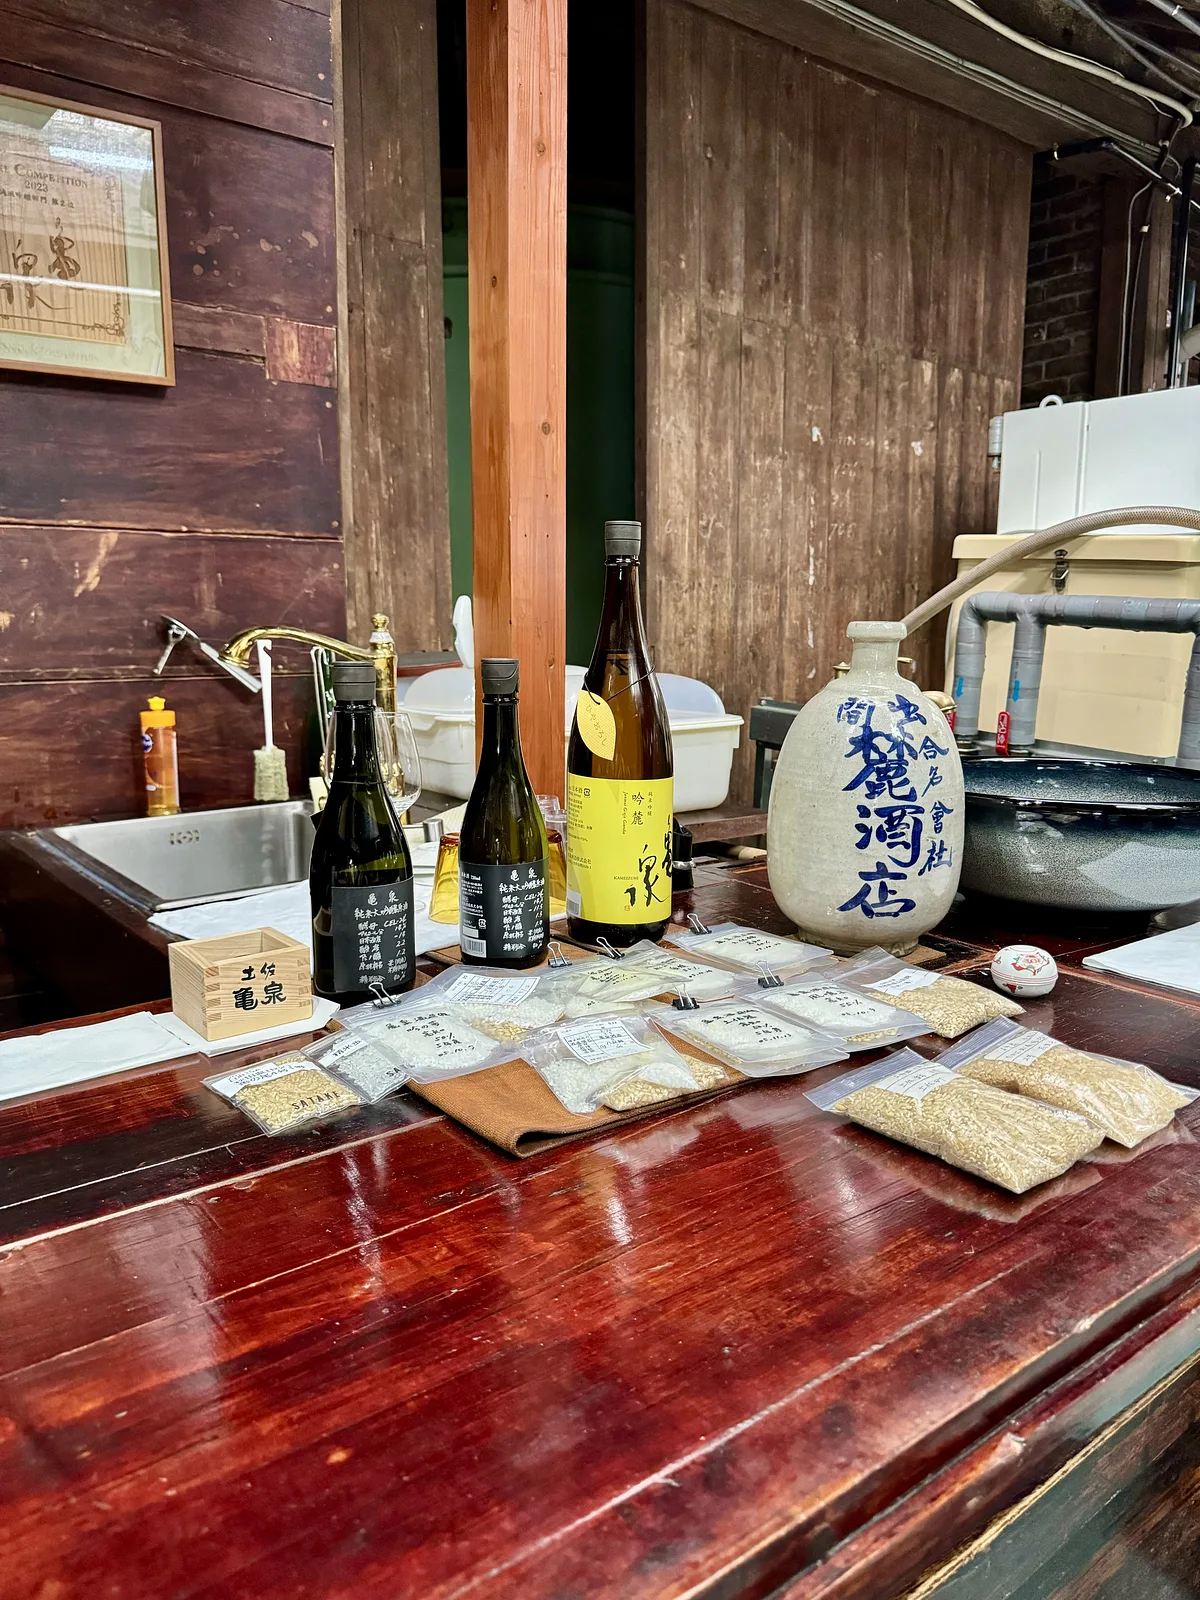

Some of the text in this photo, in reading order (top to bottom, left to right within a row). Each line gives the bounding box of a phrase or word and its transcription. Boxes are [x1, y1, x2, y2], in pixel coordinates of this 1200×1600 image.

[24, 180, 48, 192] 2023
[241, 961, 276, 981] 土佐
[232, 980, 286, 1011] 亀泉
[291, 1091, 340, 1110] SATAKE
